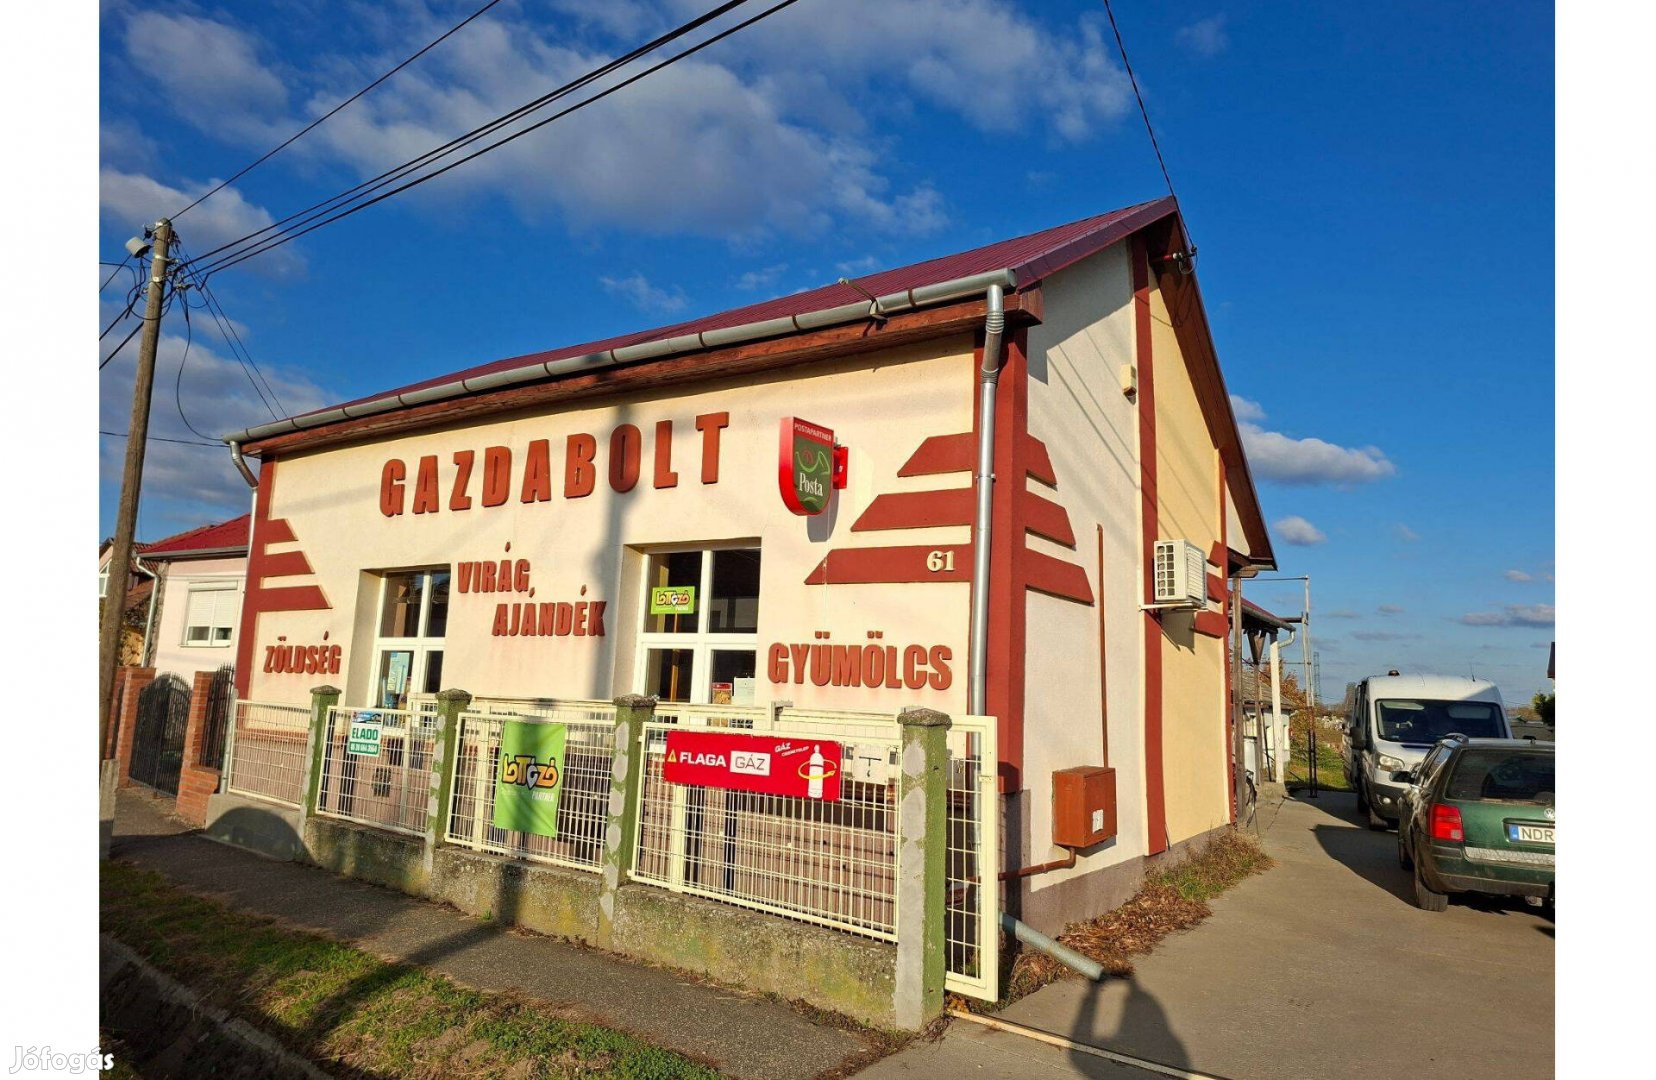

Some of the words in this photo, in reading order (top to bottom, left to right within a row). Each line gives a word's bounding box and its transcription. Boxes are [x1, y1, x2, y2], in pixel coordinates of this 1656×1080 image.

[794, 423, 832, 442] POSTAPARTNER
[379, 411, 730, 517] GAZDABOLT
[799, 472, 823, 497] Posta
[926, 550, 955, 572] 61
[263, 630, 342, 675] ZÖLDSÉG
[767, 631, 953, 690] GYÜMÖLCS
[774, 742, 791, 753] GÁZ
[680, 751, 727, 767] FLAGA
[735, 753, 766, 770] GÁZ
[1521, 827, 1555, 842] NDR
